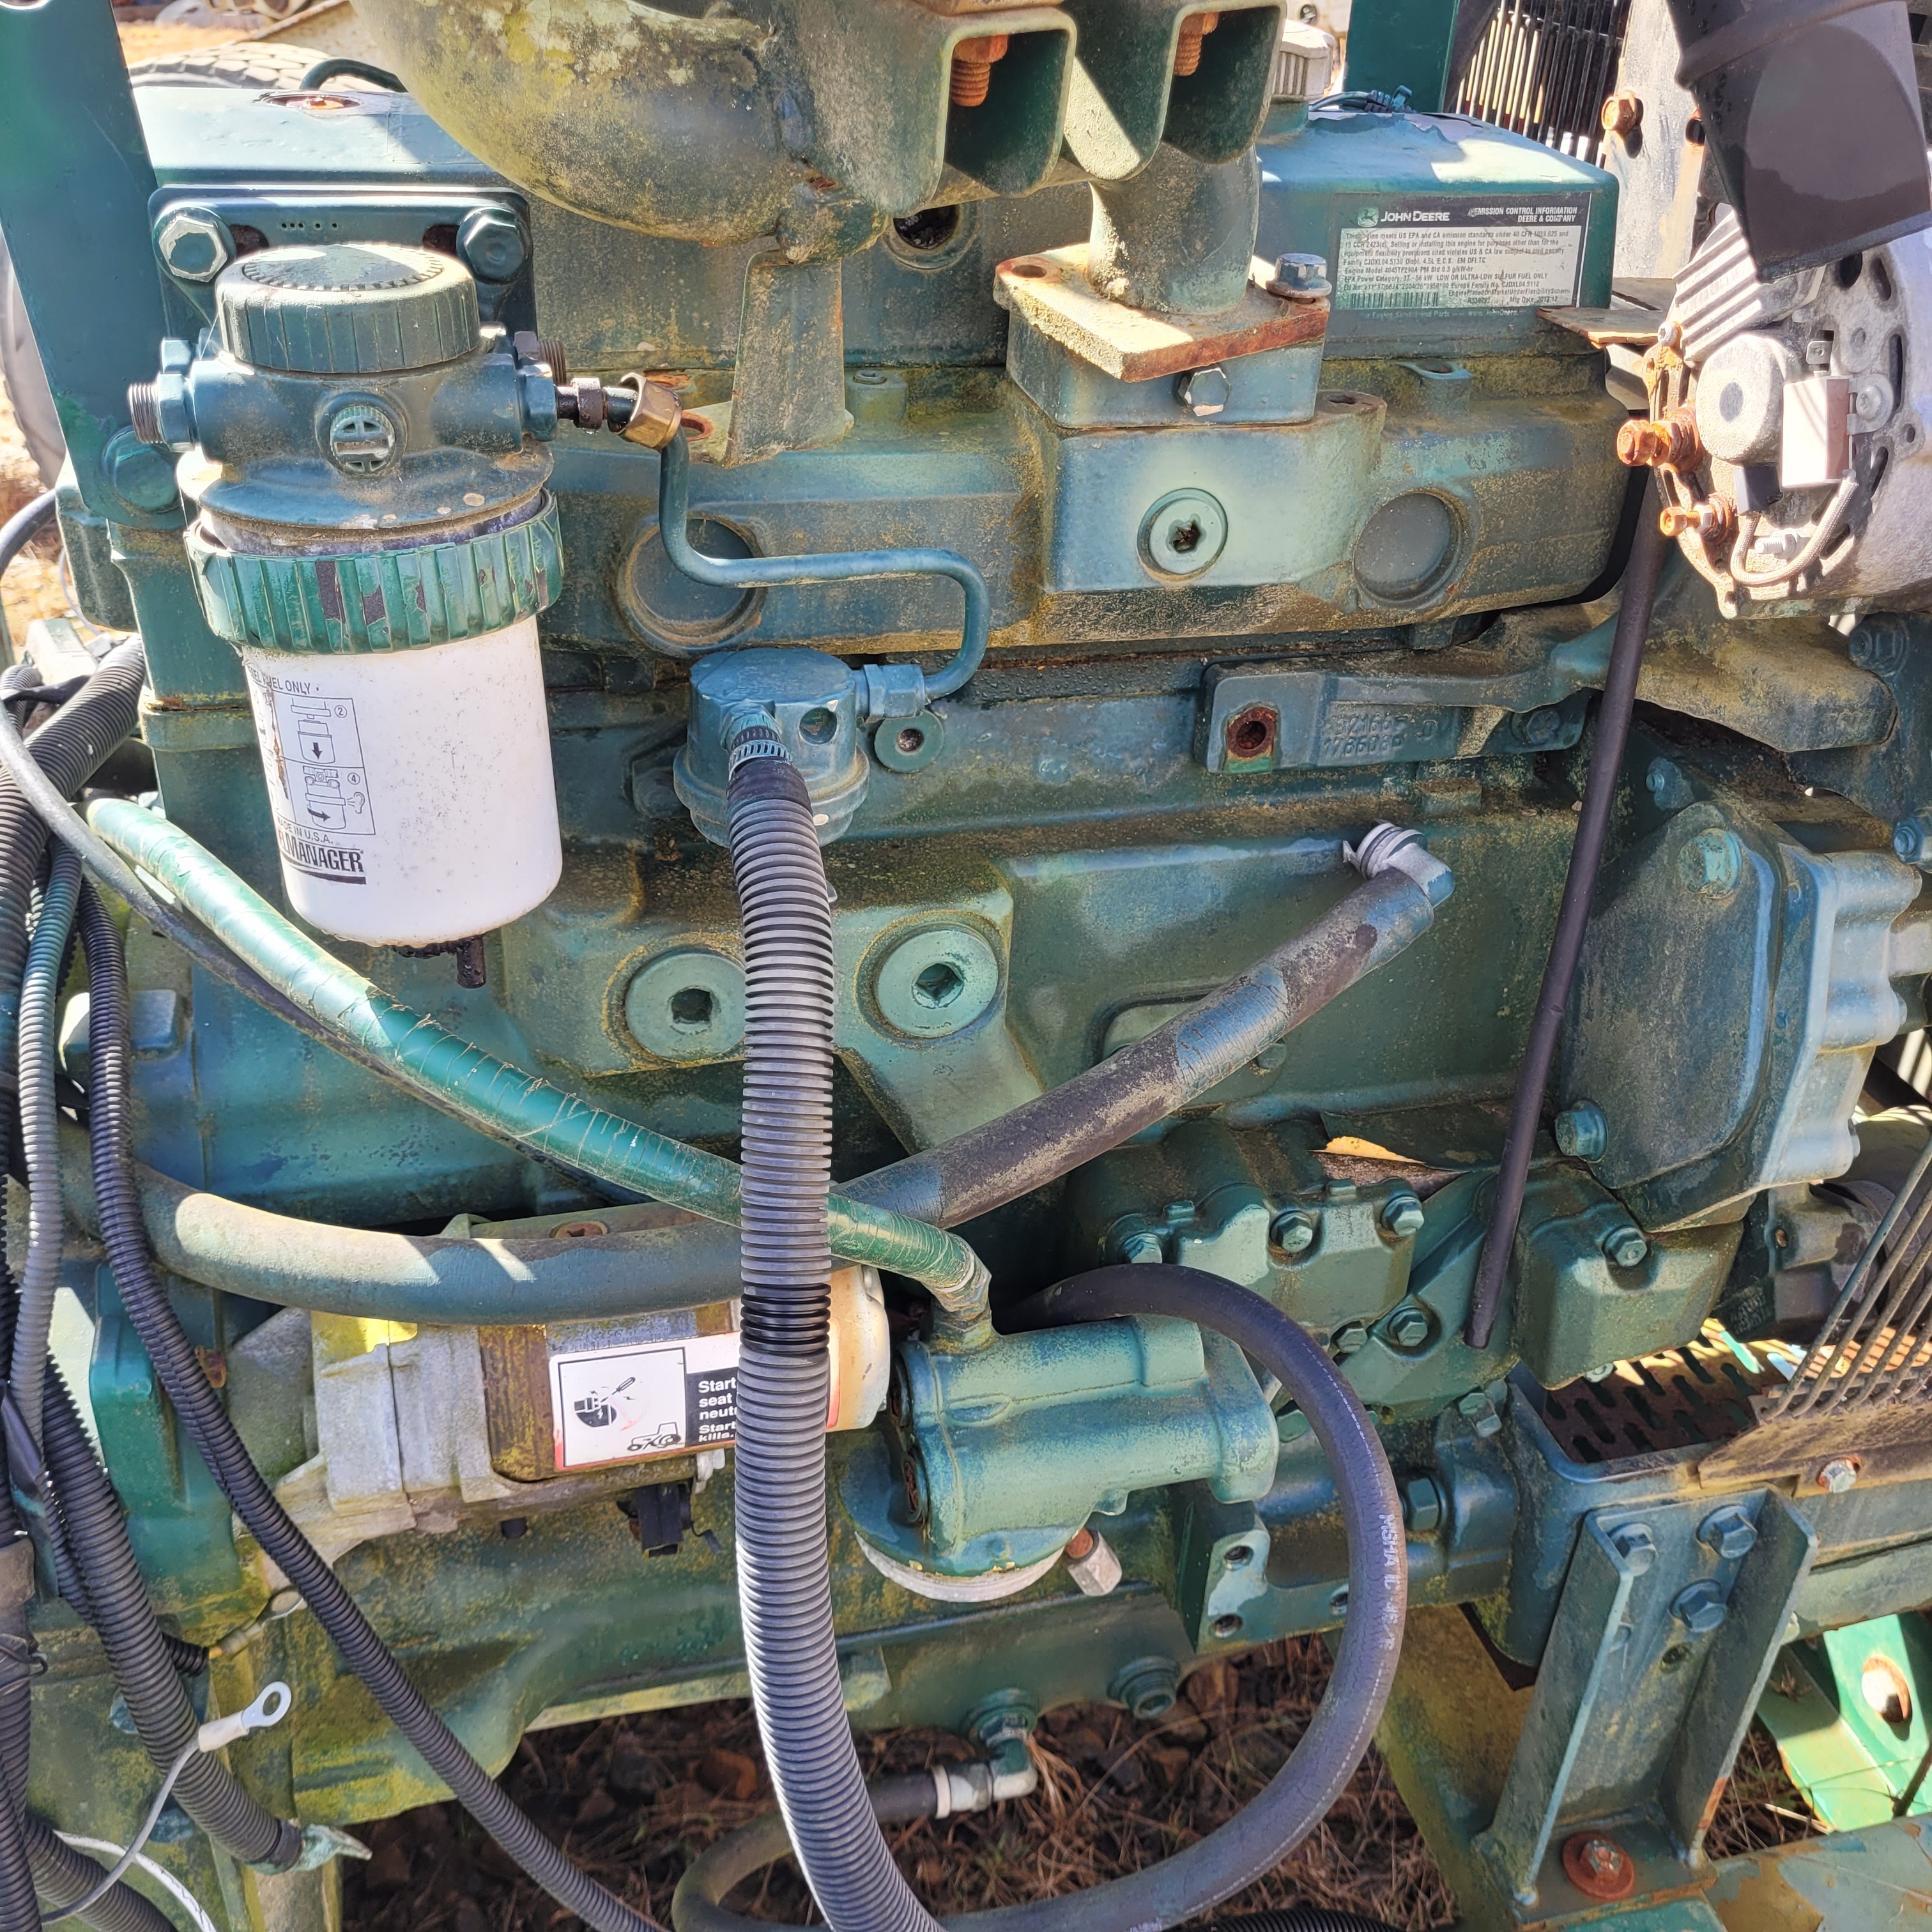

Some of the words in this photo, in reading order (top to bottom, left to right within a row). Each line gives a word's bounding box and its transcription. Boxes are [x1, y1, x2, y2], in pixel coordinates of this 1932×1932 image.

[1381, 211, 1412, 222] JOHN
[1413, 211, 1451, 222] DEERE
[1475, 207, 1504, 215] EMISSION
[1536, 206, 1577, 215] INFORMATION
[1420, 240, 1443, 249] installing
[1345, 267, 1363, 275] Engine
[285, 680, 310, 695] ONLY
[293, 825, 303, 837] IN
[304, 829, 333, 844] U.S.A.
[698, 1376, 737, 1393] Start
[698, 1392, 733, 1408] seat
[698, 1420, 737, 1434] Start
